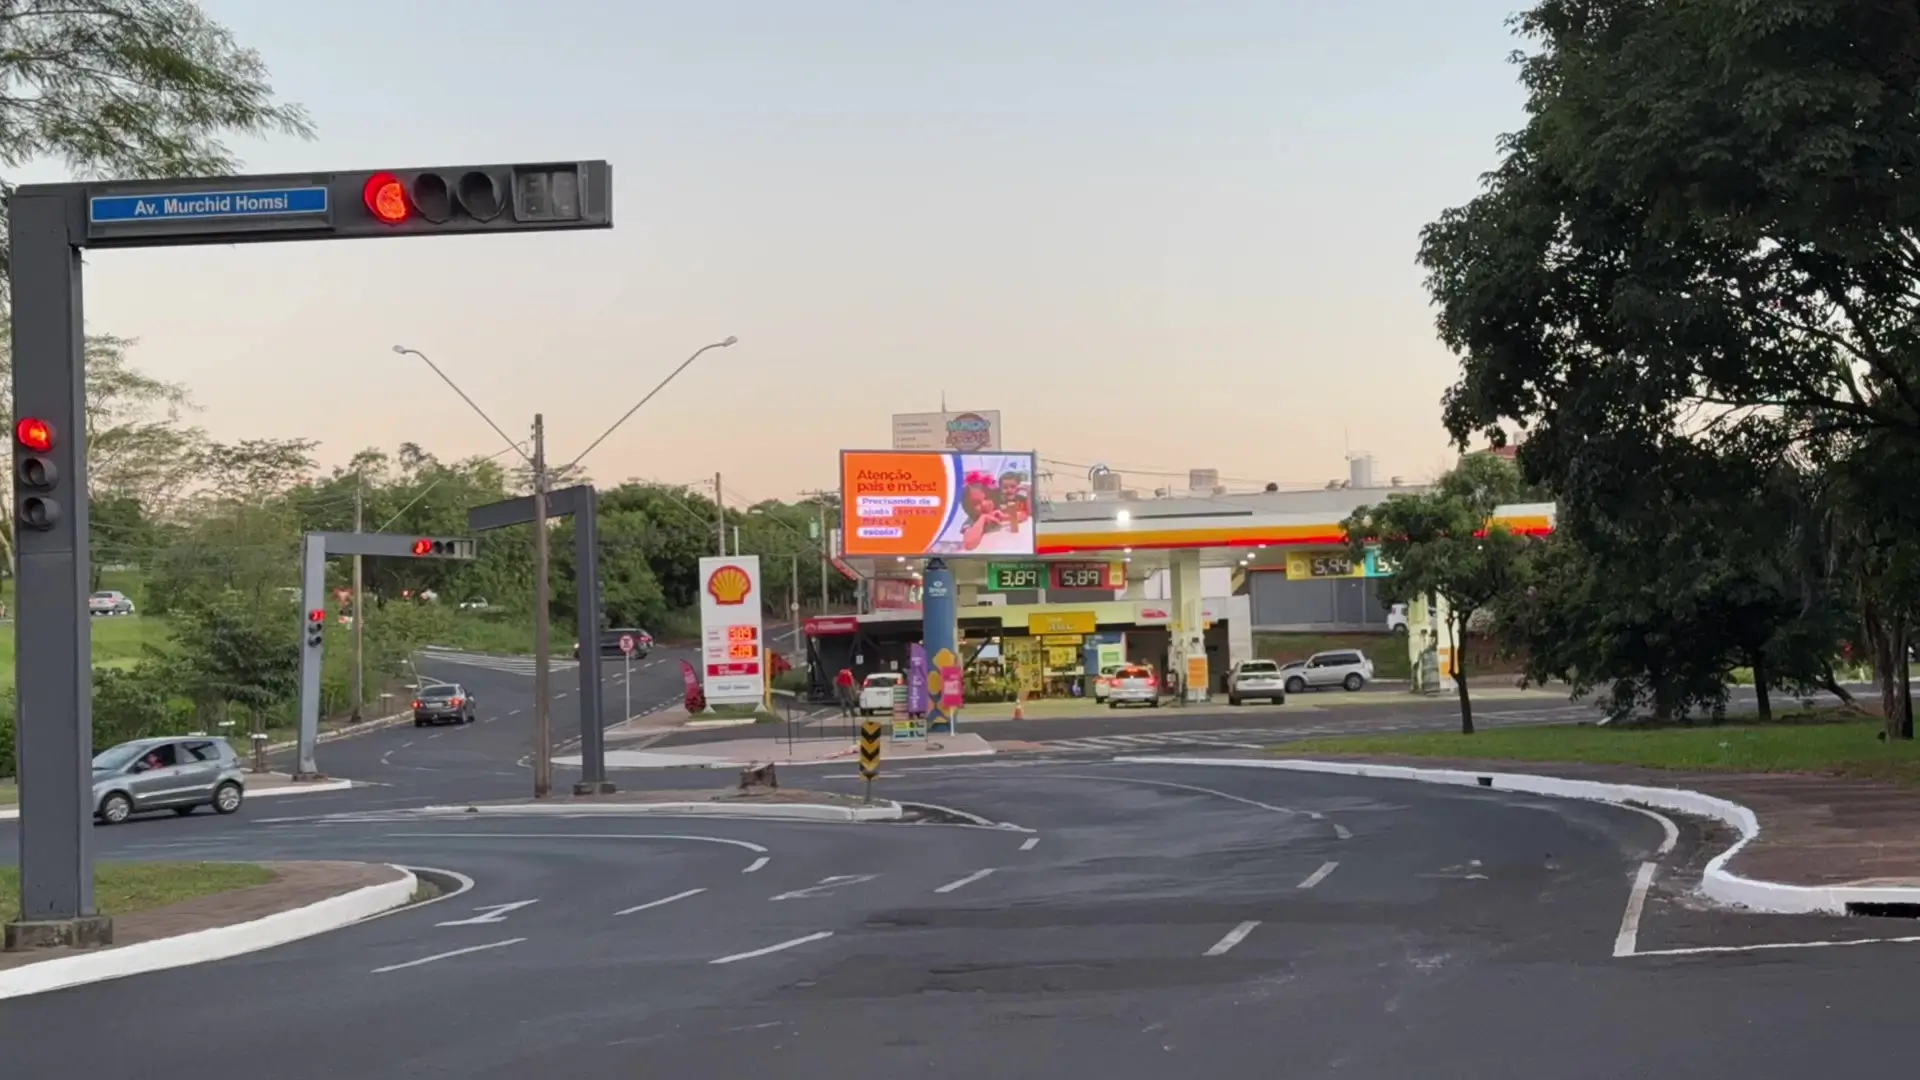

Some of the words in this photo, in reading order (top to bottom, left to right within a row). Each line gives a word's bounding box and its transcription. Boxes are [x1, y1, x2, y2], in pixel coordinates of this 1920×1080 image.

[134, 200, 158, 216] Av.
[164, 196, 230, 214] Murchid
[236, 193, 288, 211] Homsi
[857, 469, 912, 481] Atenção
[857, 481, 885, 493] pais
[887, 483, 896, 491] e
[898, 480, 937, 492] mães!
[1001, 570, 1037, 587] 3,89
[1063, 570, 1099, 587] 5,89
